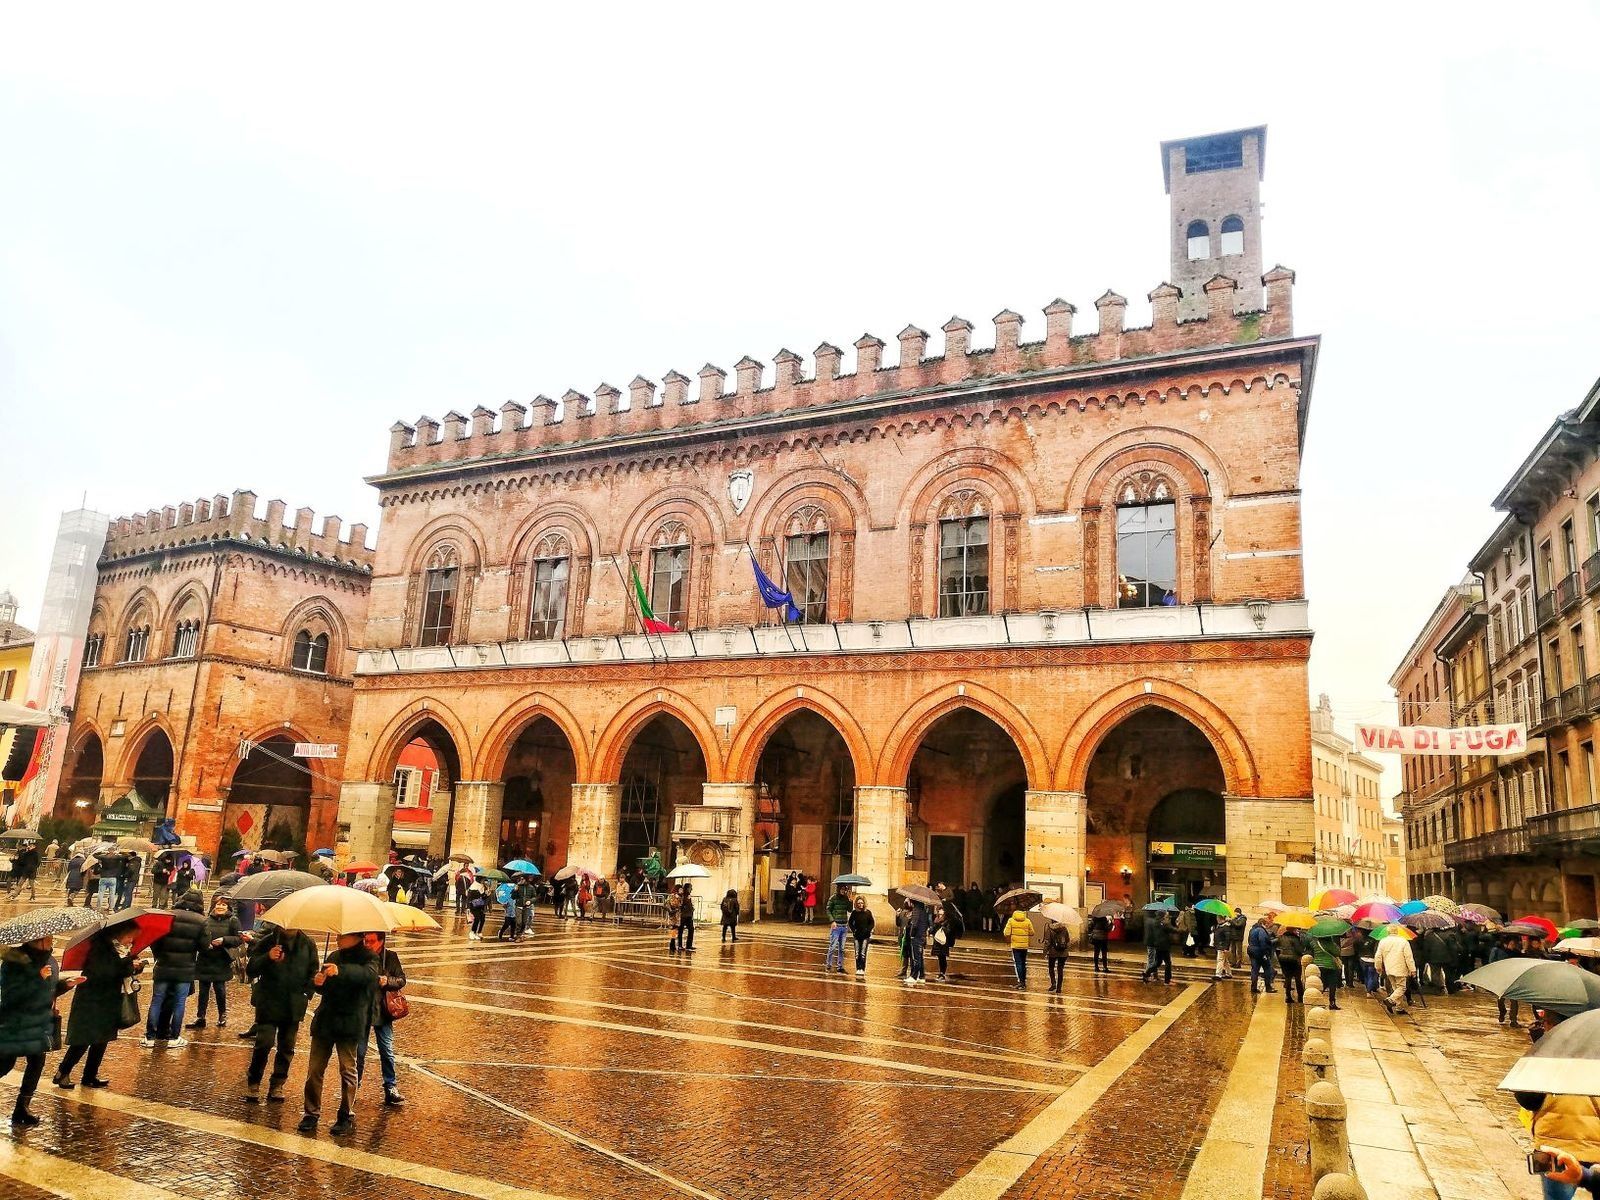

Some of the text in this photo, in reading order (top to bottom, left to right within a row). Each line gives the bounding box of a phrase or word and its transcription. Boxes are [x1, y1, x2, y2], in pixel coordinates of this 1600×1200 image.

[1360, 728, 1523, 749] VIA DI FUGA
[1176, 848, 1213, 856] INFOPOINT
